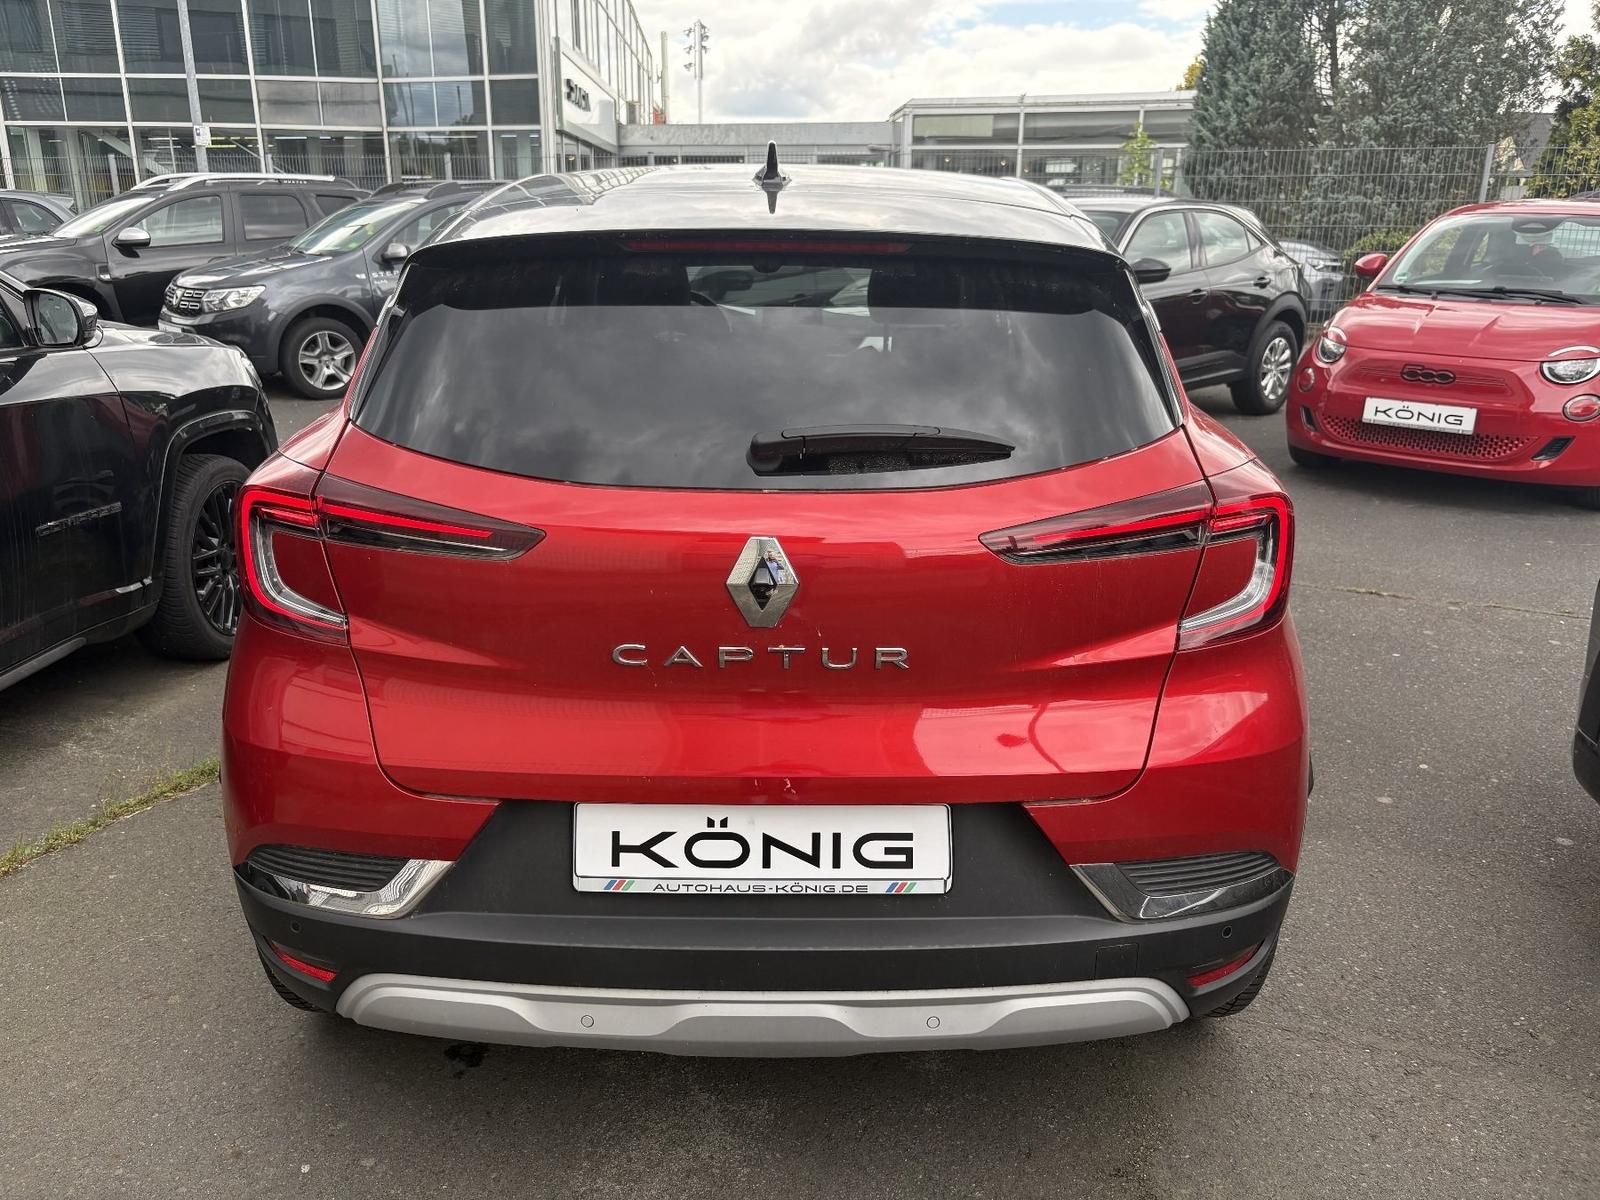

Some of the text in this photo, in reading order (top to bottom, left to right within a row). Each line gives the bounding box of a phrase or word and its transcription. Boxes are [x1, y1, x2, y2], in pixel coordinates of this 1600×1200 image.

[1402, 364, 1456, 383] 500
[1374, 405, 1465, 426] KÖNIG
[612, 643, 910, 668] CAPTUR
[610, 816, 915, 870] KÖNIG
[652, 881, 870, 894] AUTOHAUS-KÖNIG.DE
